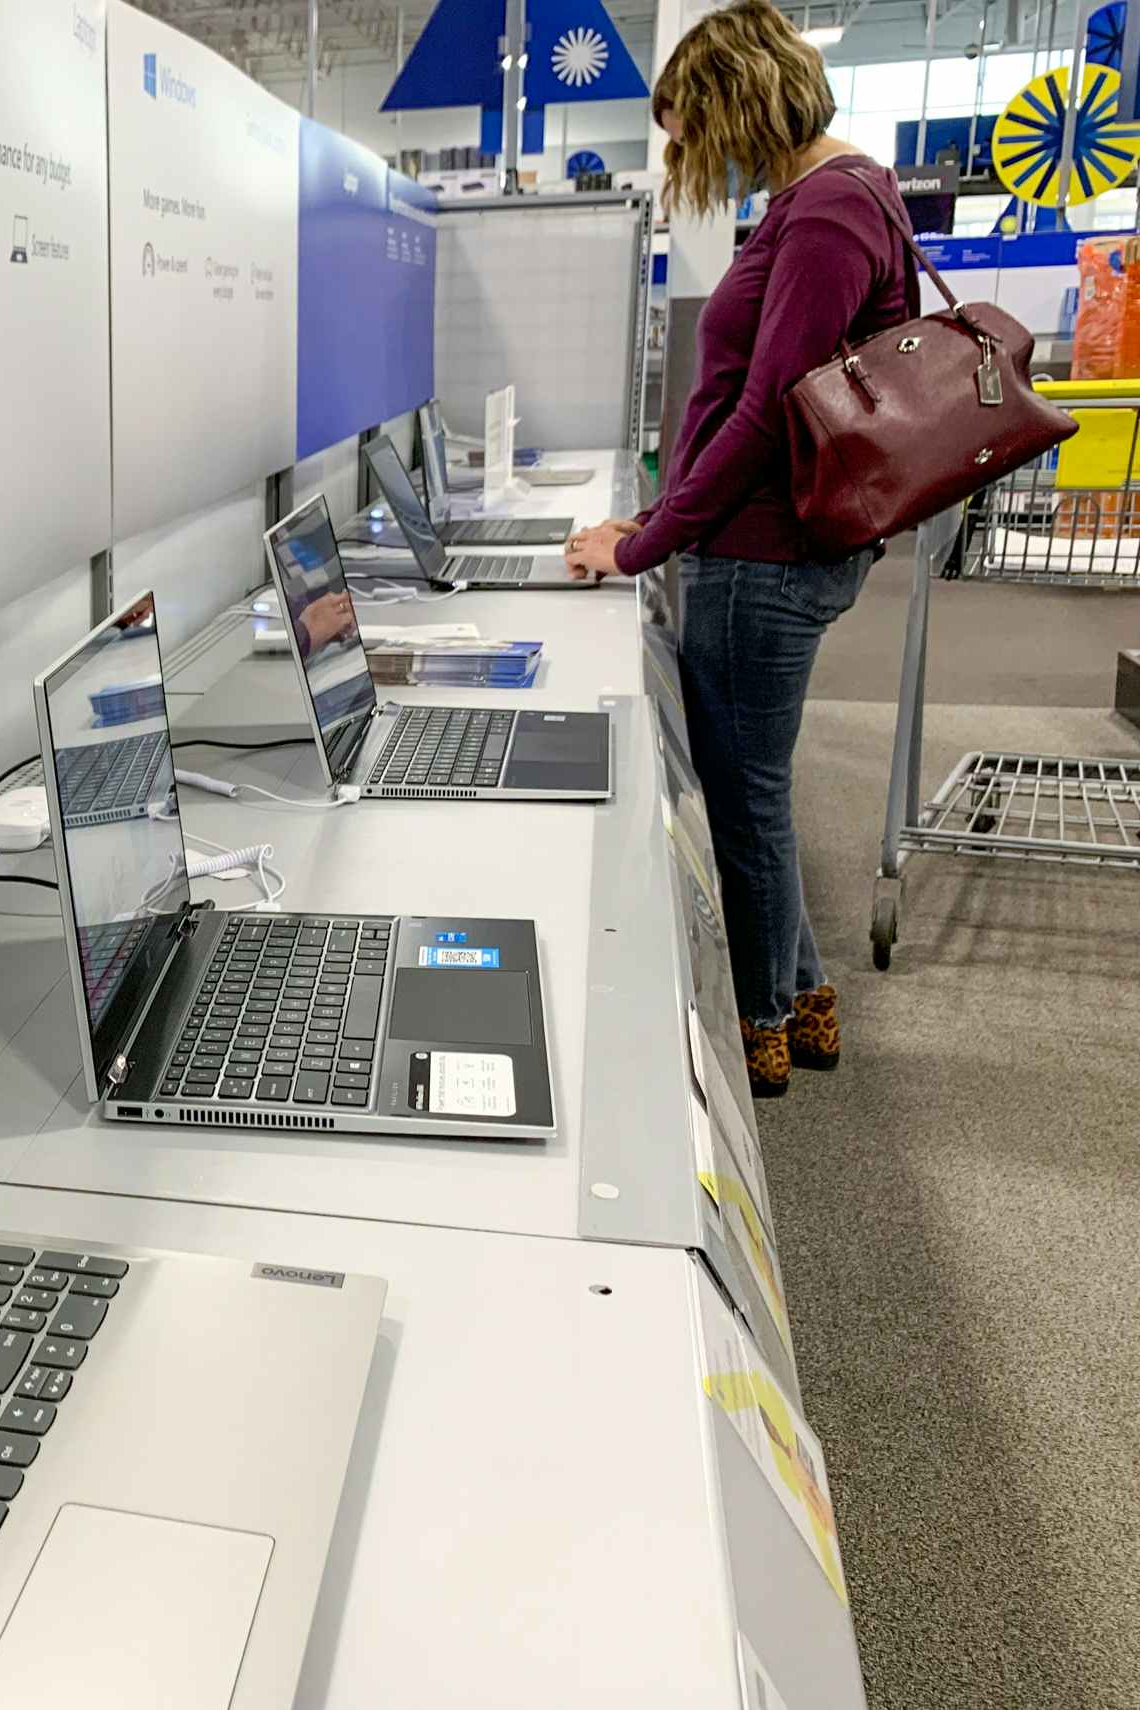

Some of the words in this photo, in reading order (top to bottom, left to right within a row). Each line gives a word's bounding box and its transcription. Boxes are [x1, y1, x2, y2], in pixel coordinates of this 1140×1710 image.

[160, 65, 196, 109] Windows
[23, 138, 35, 171] for
[36, 152, 48, 184] any
[898, 179, 941, 191] erizon
[261, 1267, 336, 1285] Lenovo
